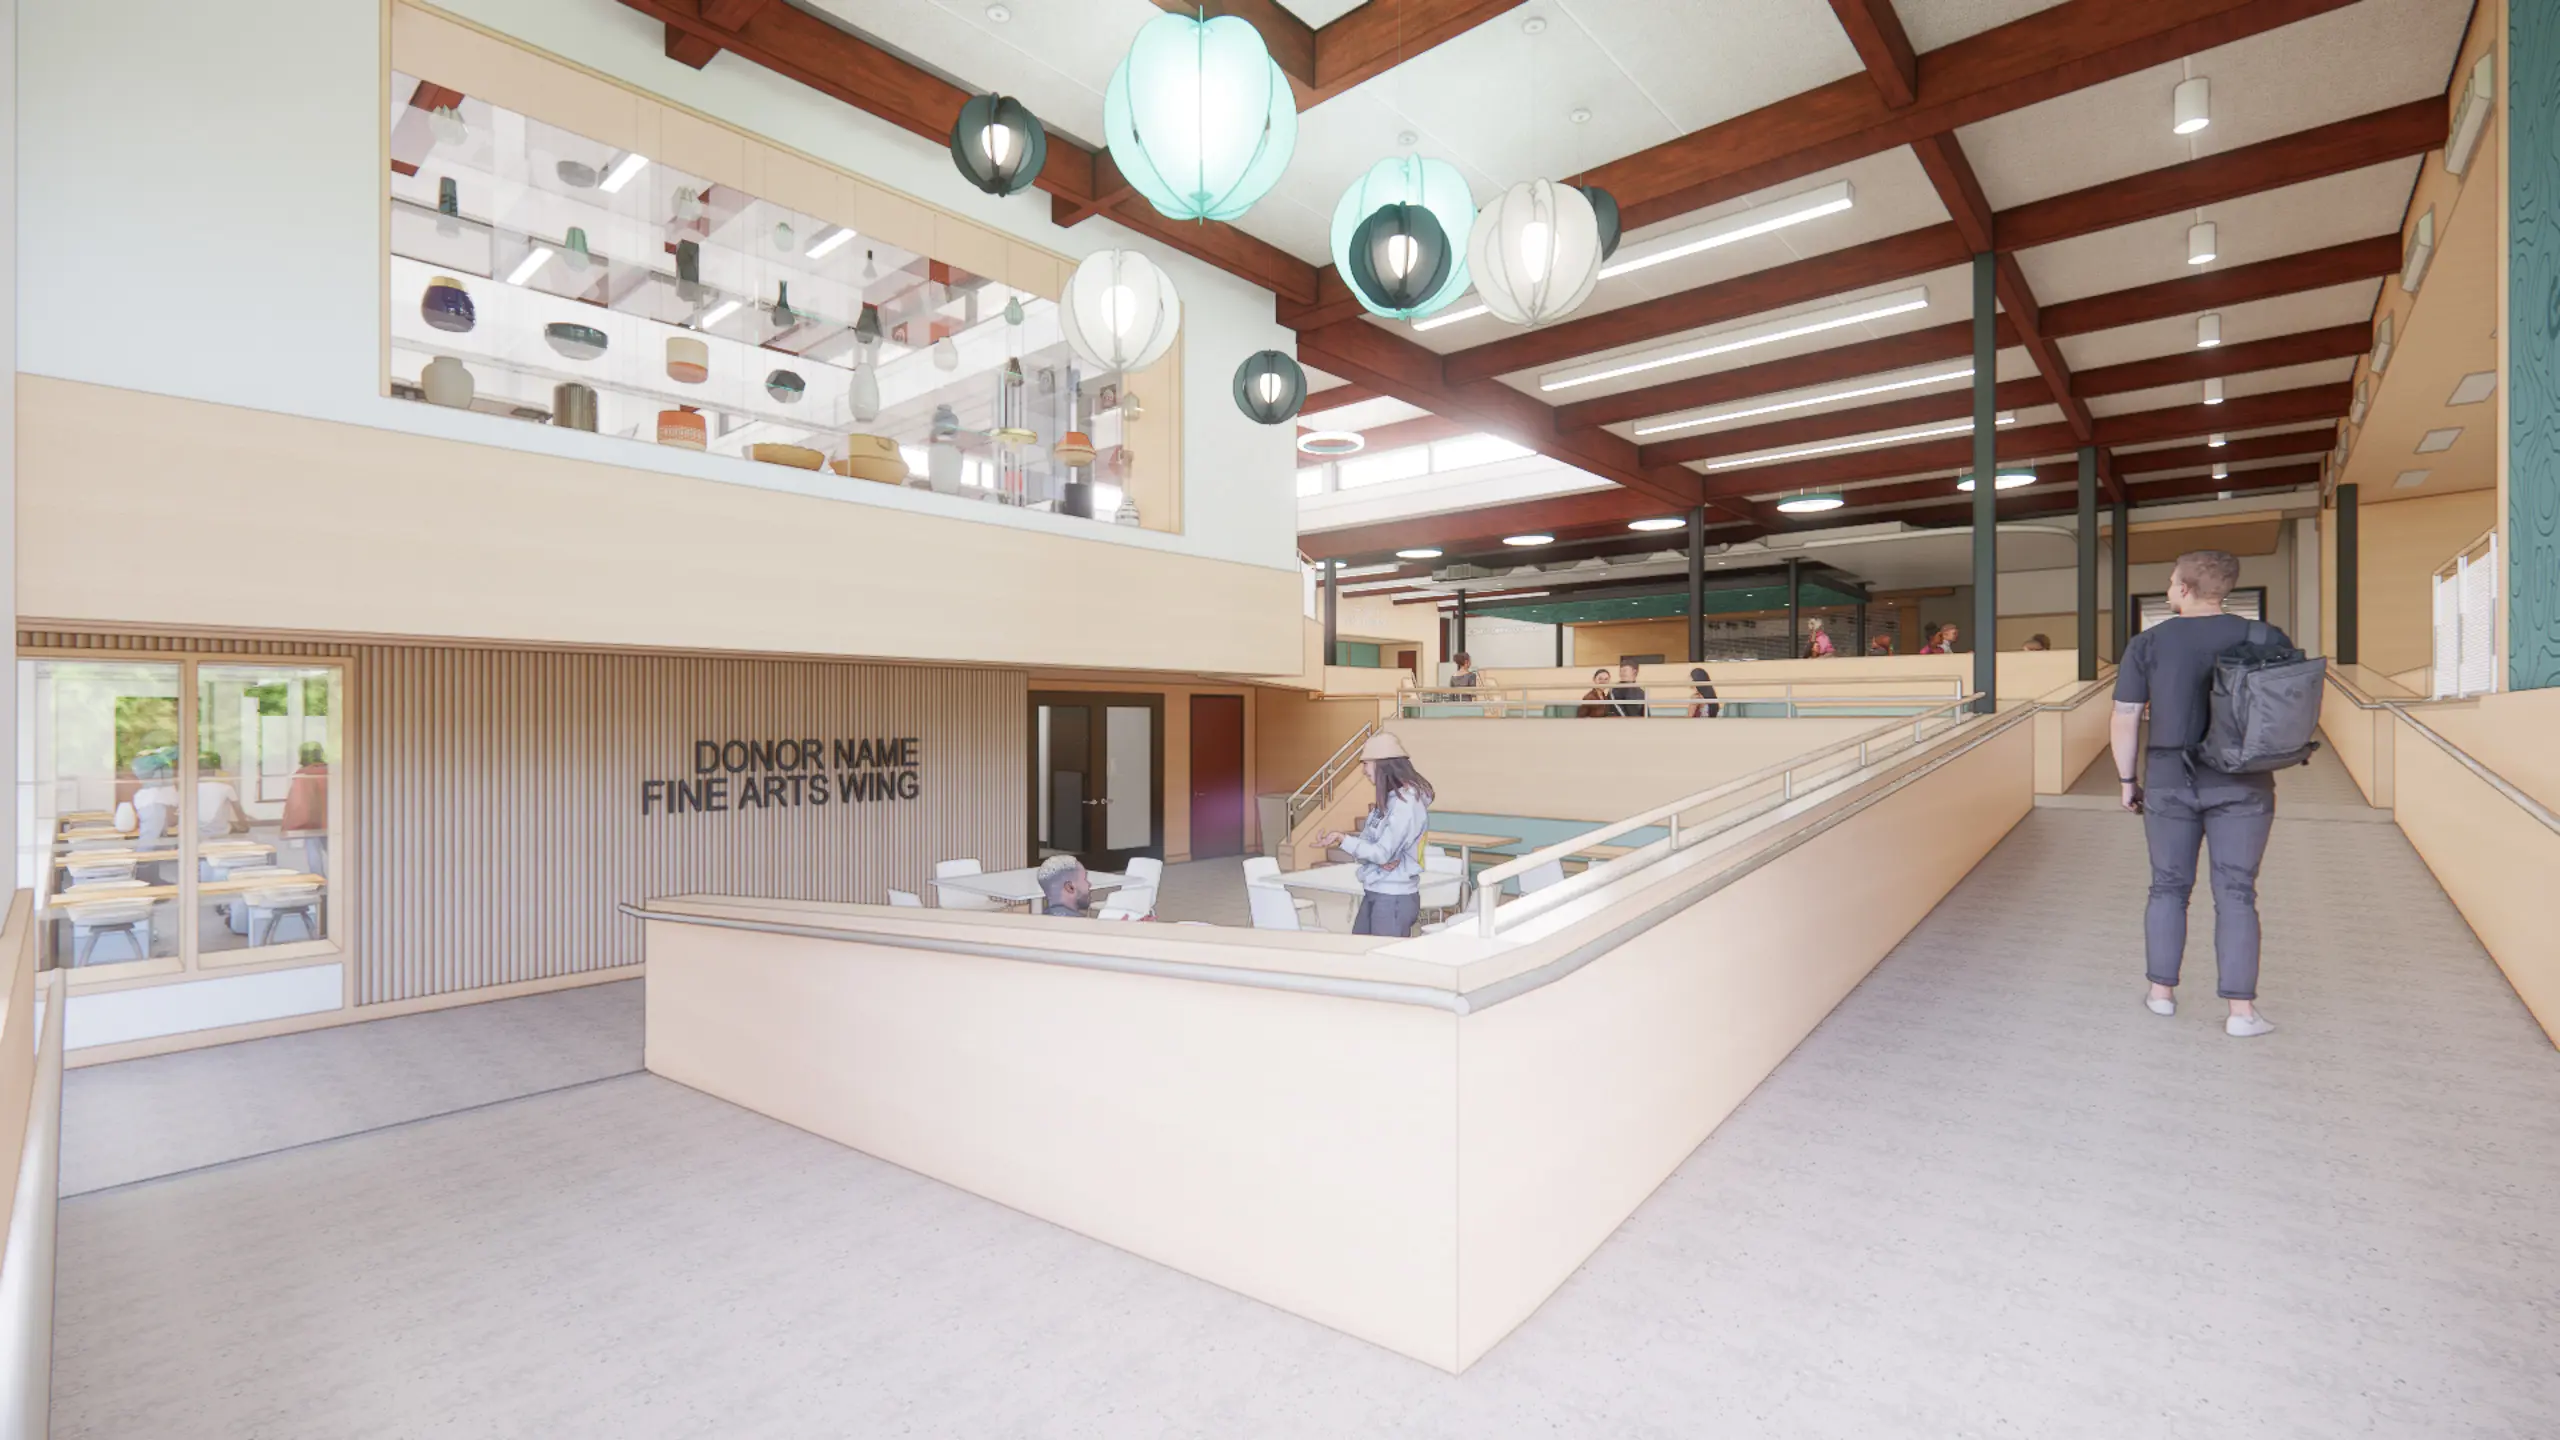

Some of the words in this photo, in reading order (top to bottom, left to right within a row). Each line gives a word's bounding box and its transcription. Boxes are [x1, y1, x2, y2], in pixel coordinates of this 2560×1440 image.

[695, 738, 824, 774] DONOR
[834, 737, 919, 769] NAME
[642, 778, 728, 815] FINE
[738, 774, 829, 810] ARTS
[838, 771, 920, 803] WING
